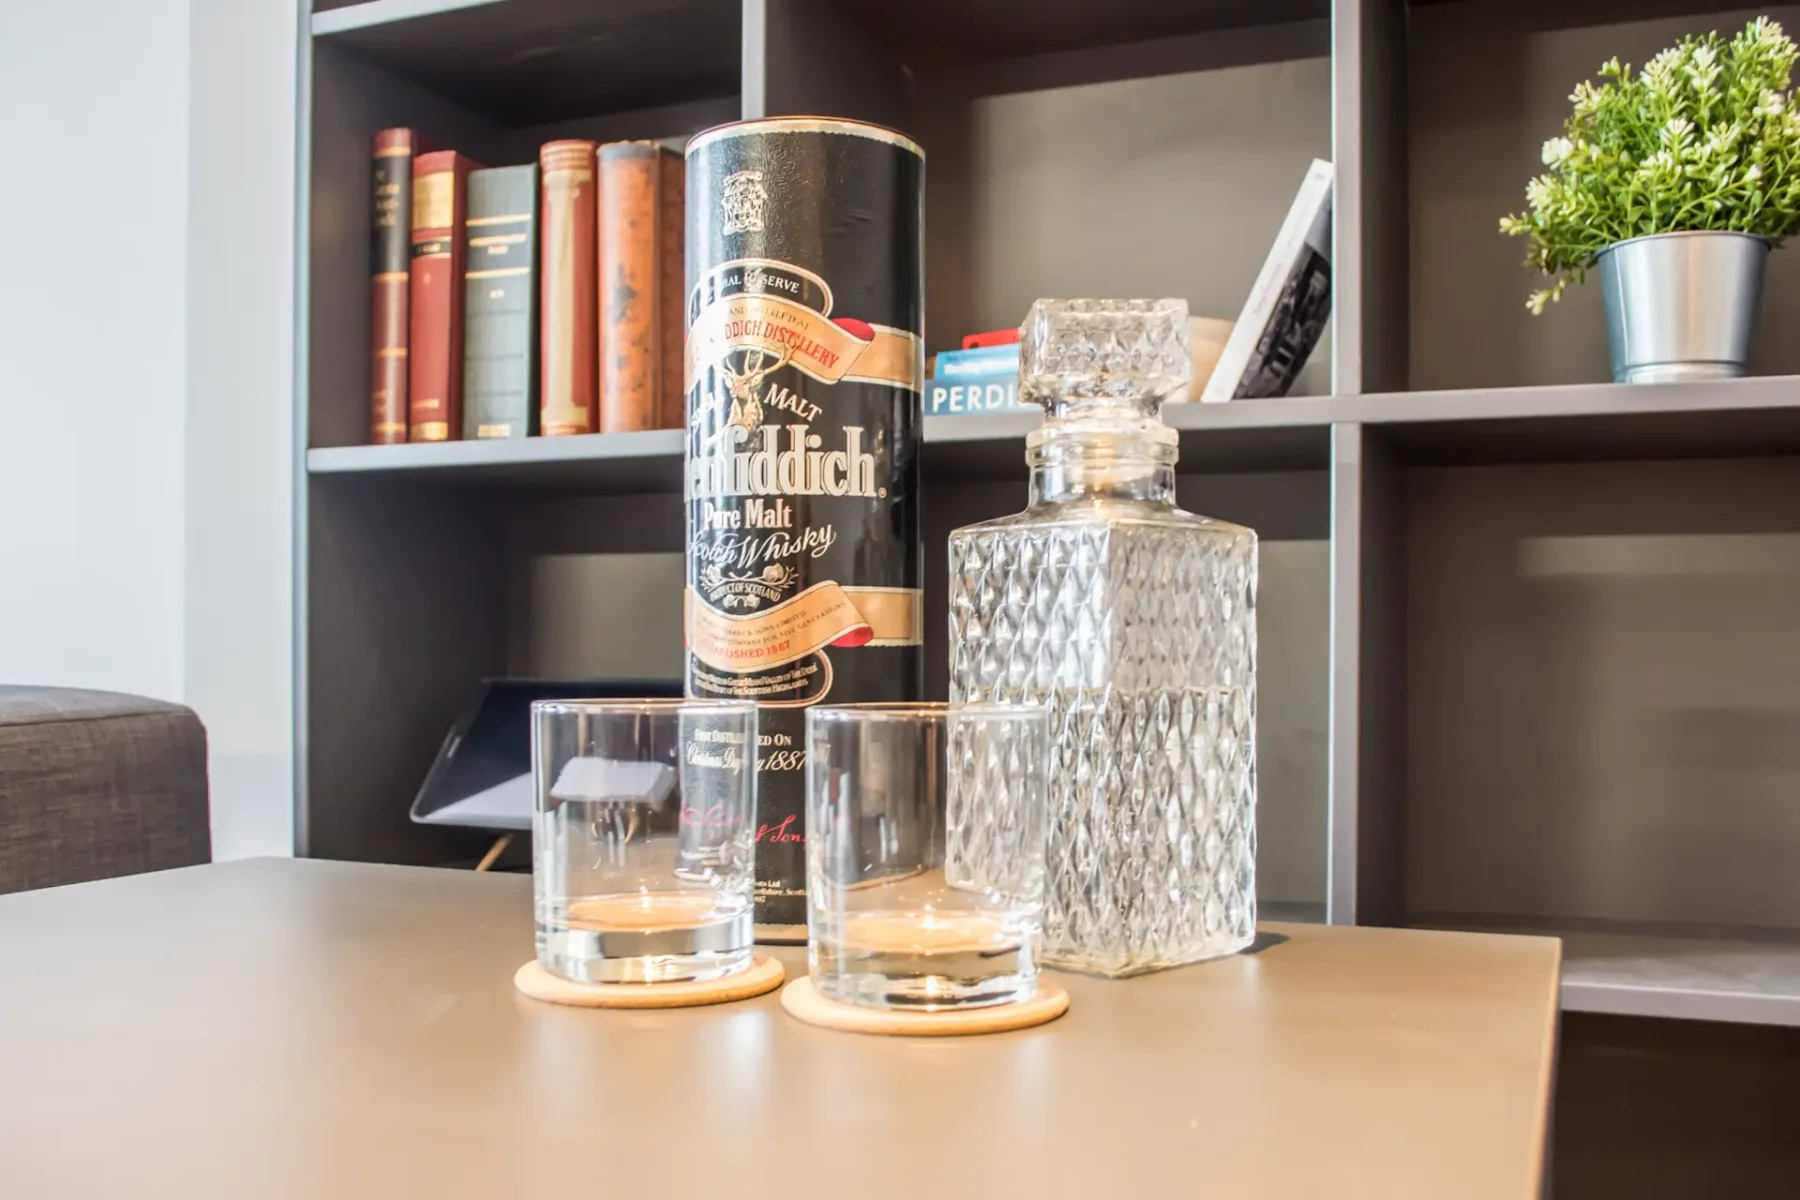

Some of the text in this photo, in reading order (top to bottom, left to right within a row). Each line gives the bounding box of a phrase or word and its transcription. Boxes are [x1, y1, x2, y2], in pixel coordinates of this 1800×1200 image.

[752, 274, 800, 294] SERVE
[764, 322, 840, 369] DISTILLERY
[763, 383, 823, 422] MALT
[932, 382, 1015, 413] PERDI
[688, 424, 878, 498] enfiddich
[703, 498, 793, 530] Pure Malt
[737, 524, 837, 569] Whisky
[744, 583, 781, 602] SCOTLAND
[774, 733, 792, 747] ON
[769, 815, 807, 844] Son
